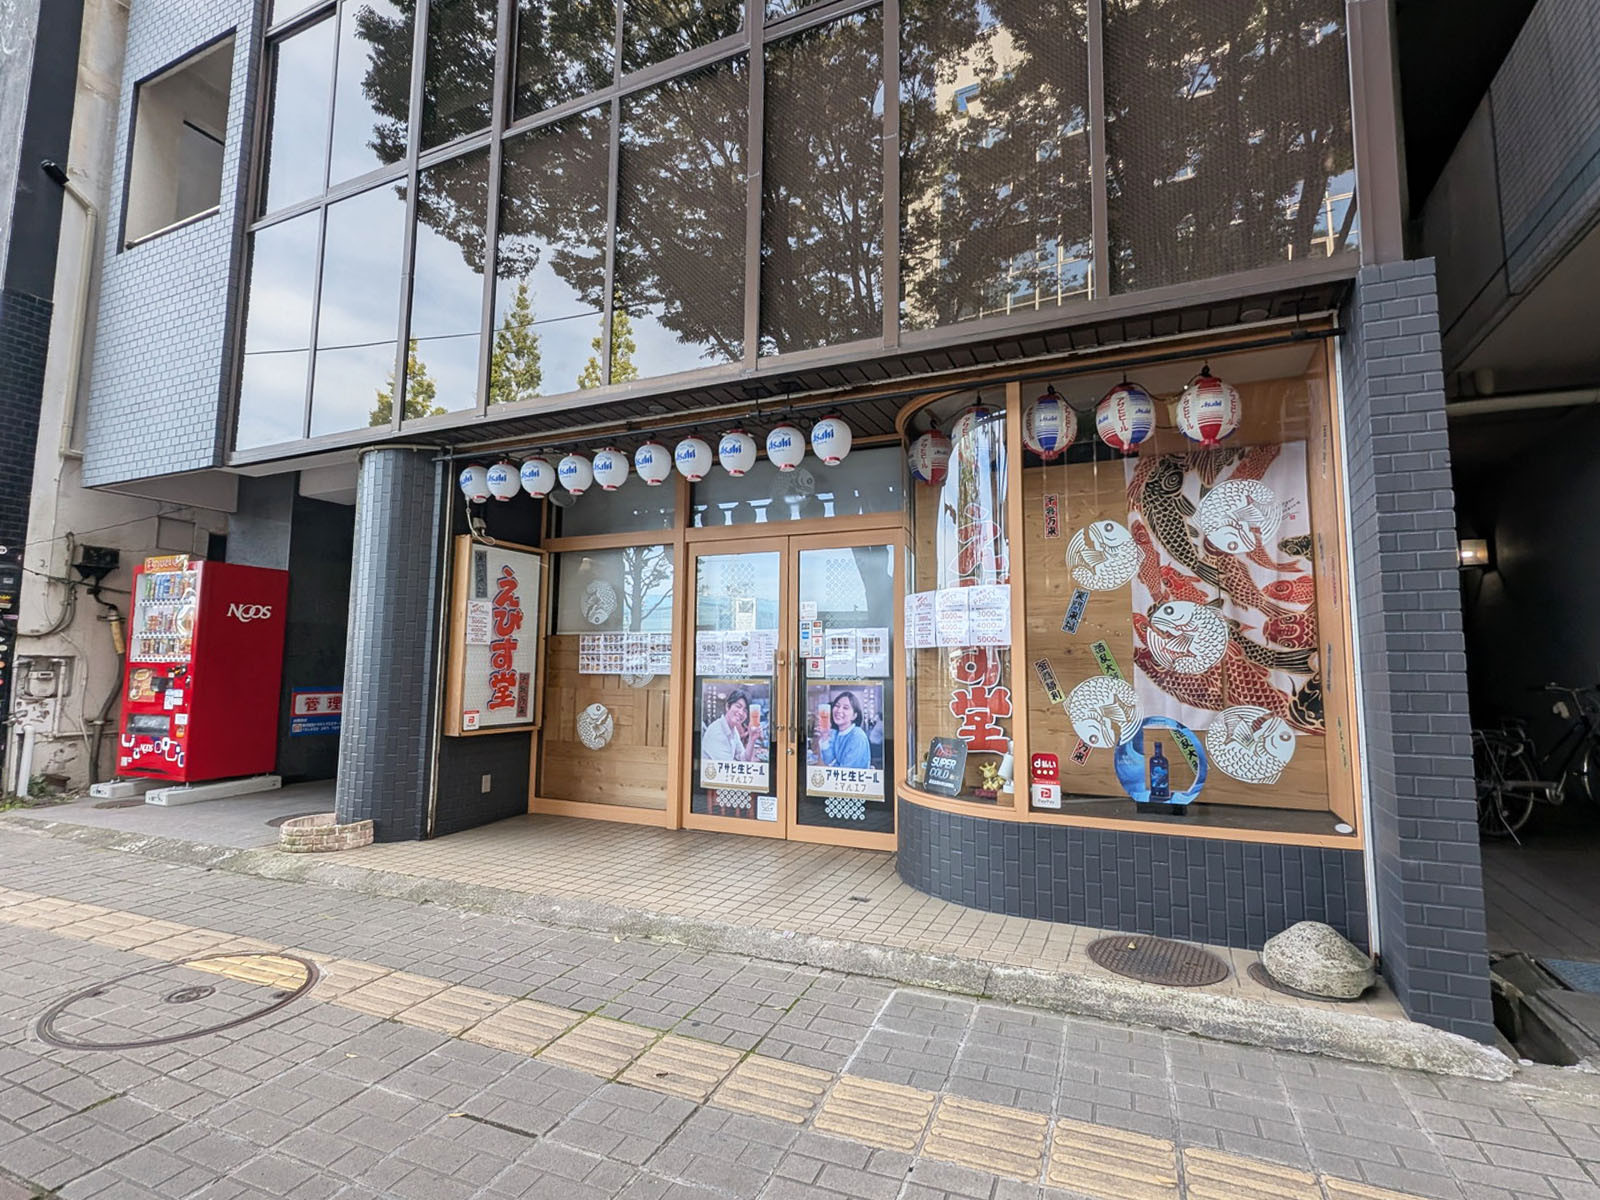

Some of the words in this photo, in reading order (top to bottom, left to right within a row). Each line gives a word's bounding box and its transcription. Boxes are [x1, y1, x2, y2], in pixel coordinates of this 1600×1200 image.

[813, 428, 834, 442] Asahi
[768, 437, 792, 450] Asahi
[948, 502, 1013, 755] えす堂
[487, 564, 524, 711] えびす堂
[976, 635, 998, 643] 5000
[717, 762, 766, 776] アサヒ生ビール
[931, 756, 957, 769] SUPER
[825, 769, 880, 784] アサヒ生ビール
